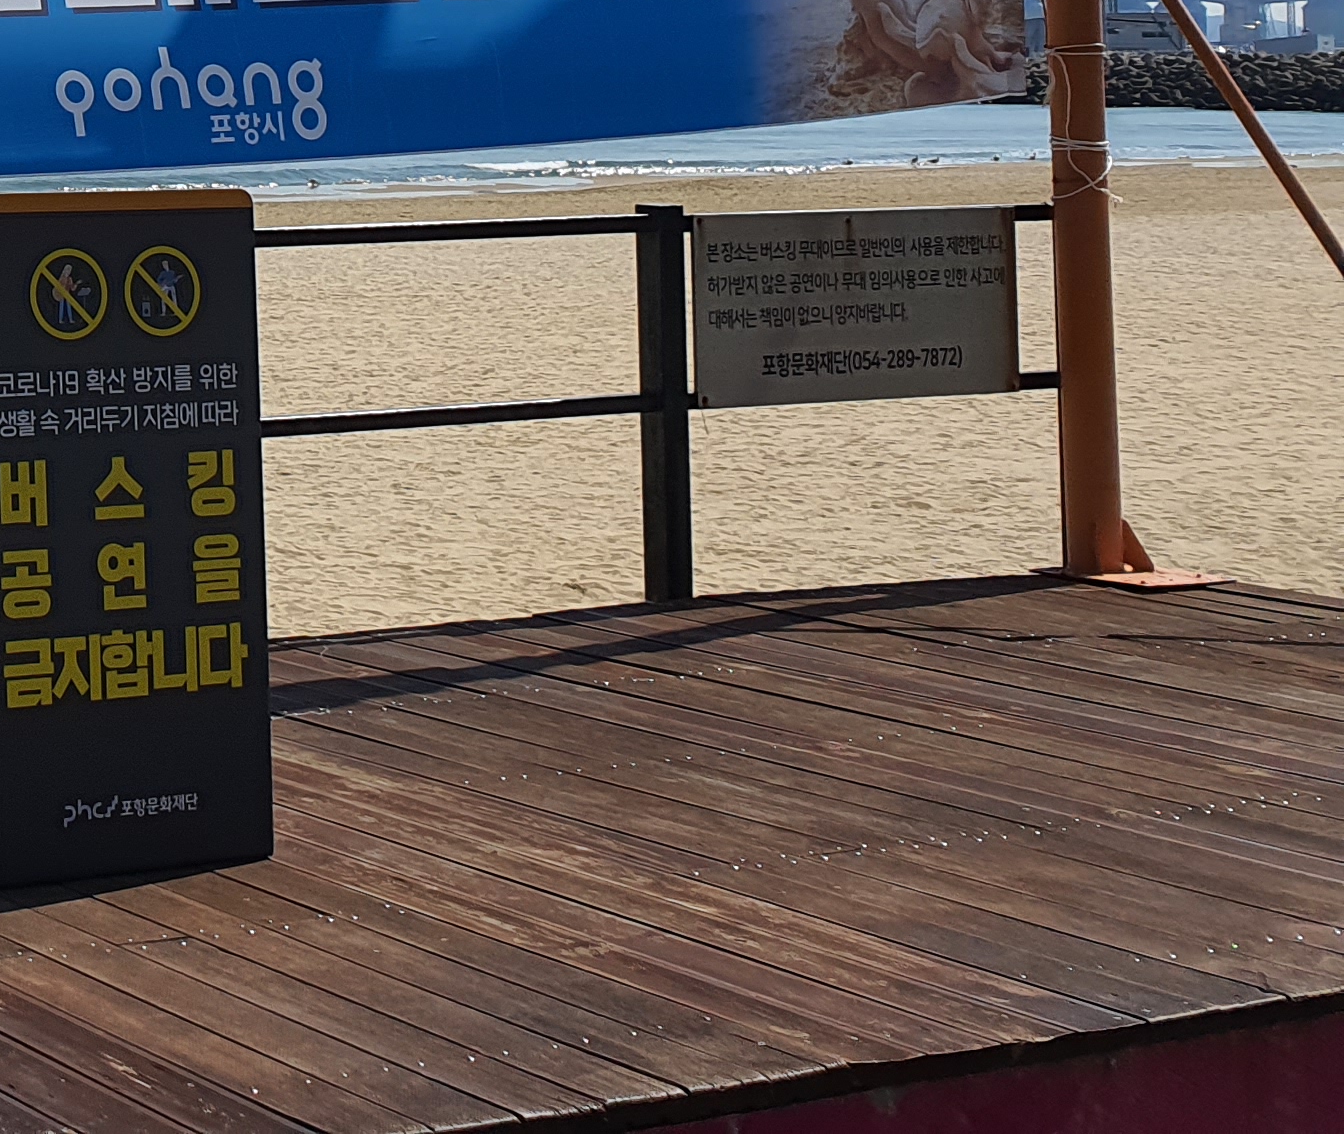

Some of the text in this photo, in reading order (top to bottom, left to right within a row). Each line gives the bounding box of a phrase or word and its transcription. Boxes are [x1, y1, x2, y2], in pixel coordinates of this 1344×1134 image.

[55, 46, 327, 141] pohang
[209, 110, 286, 145] 포항시
[706, 242, 720, 263] 본
[721, 241, 759, 263] 장소는
[760, 240, 797, 262] 버스킹
[798, 238, 859, 260] 무대이므로
[859, 236, 906, 259] 일반인의
[909, 235, 945, 257] 사용을
[706, 266, 1006, 297] 허가받지 않은 공연이나 무대 임의사용으로 인한 사고에
[708, 307, 758, 330] 대해서는
[759, 306, 796, 328] 책임이
[797, 304, 834, 327] 없으니
[761, 344, 963, 378] 포항문화재단(054-289-7872)
[85, 367, 126, 396] 확산
[132, 363, 193, 394] 방지를
[198, 361, 238, 390] 위한
[39, 407, 60, 436] 속
[63, 404, 139, 435] 거리두기
[142, 401, 199, 431] 지침에
[201, 399, 240, 427] 따라
[3, 621, 249, 710] 금지합니다
[120, 792, 199, 817] 포항문화재단
